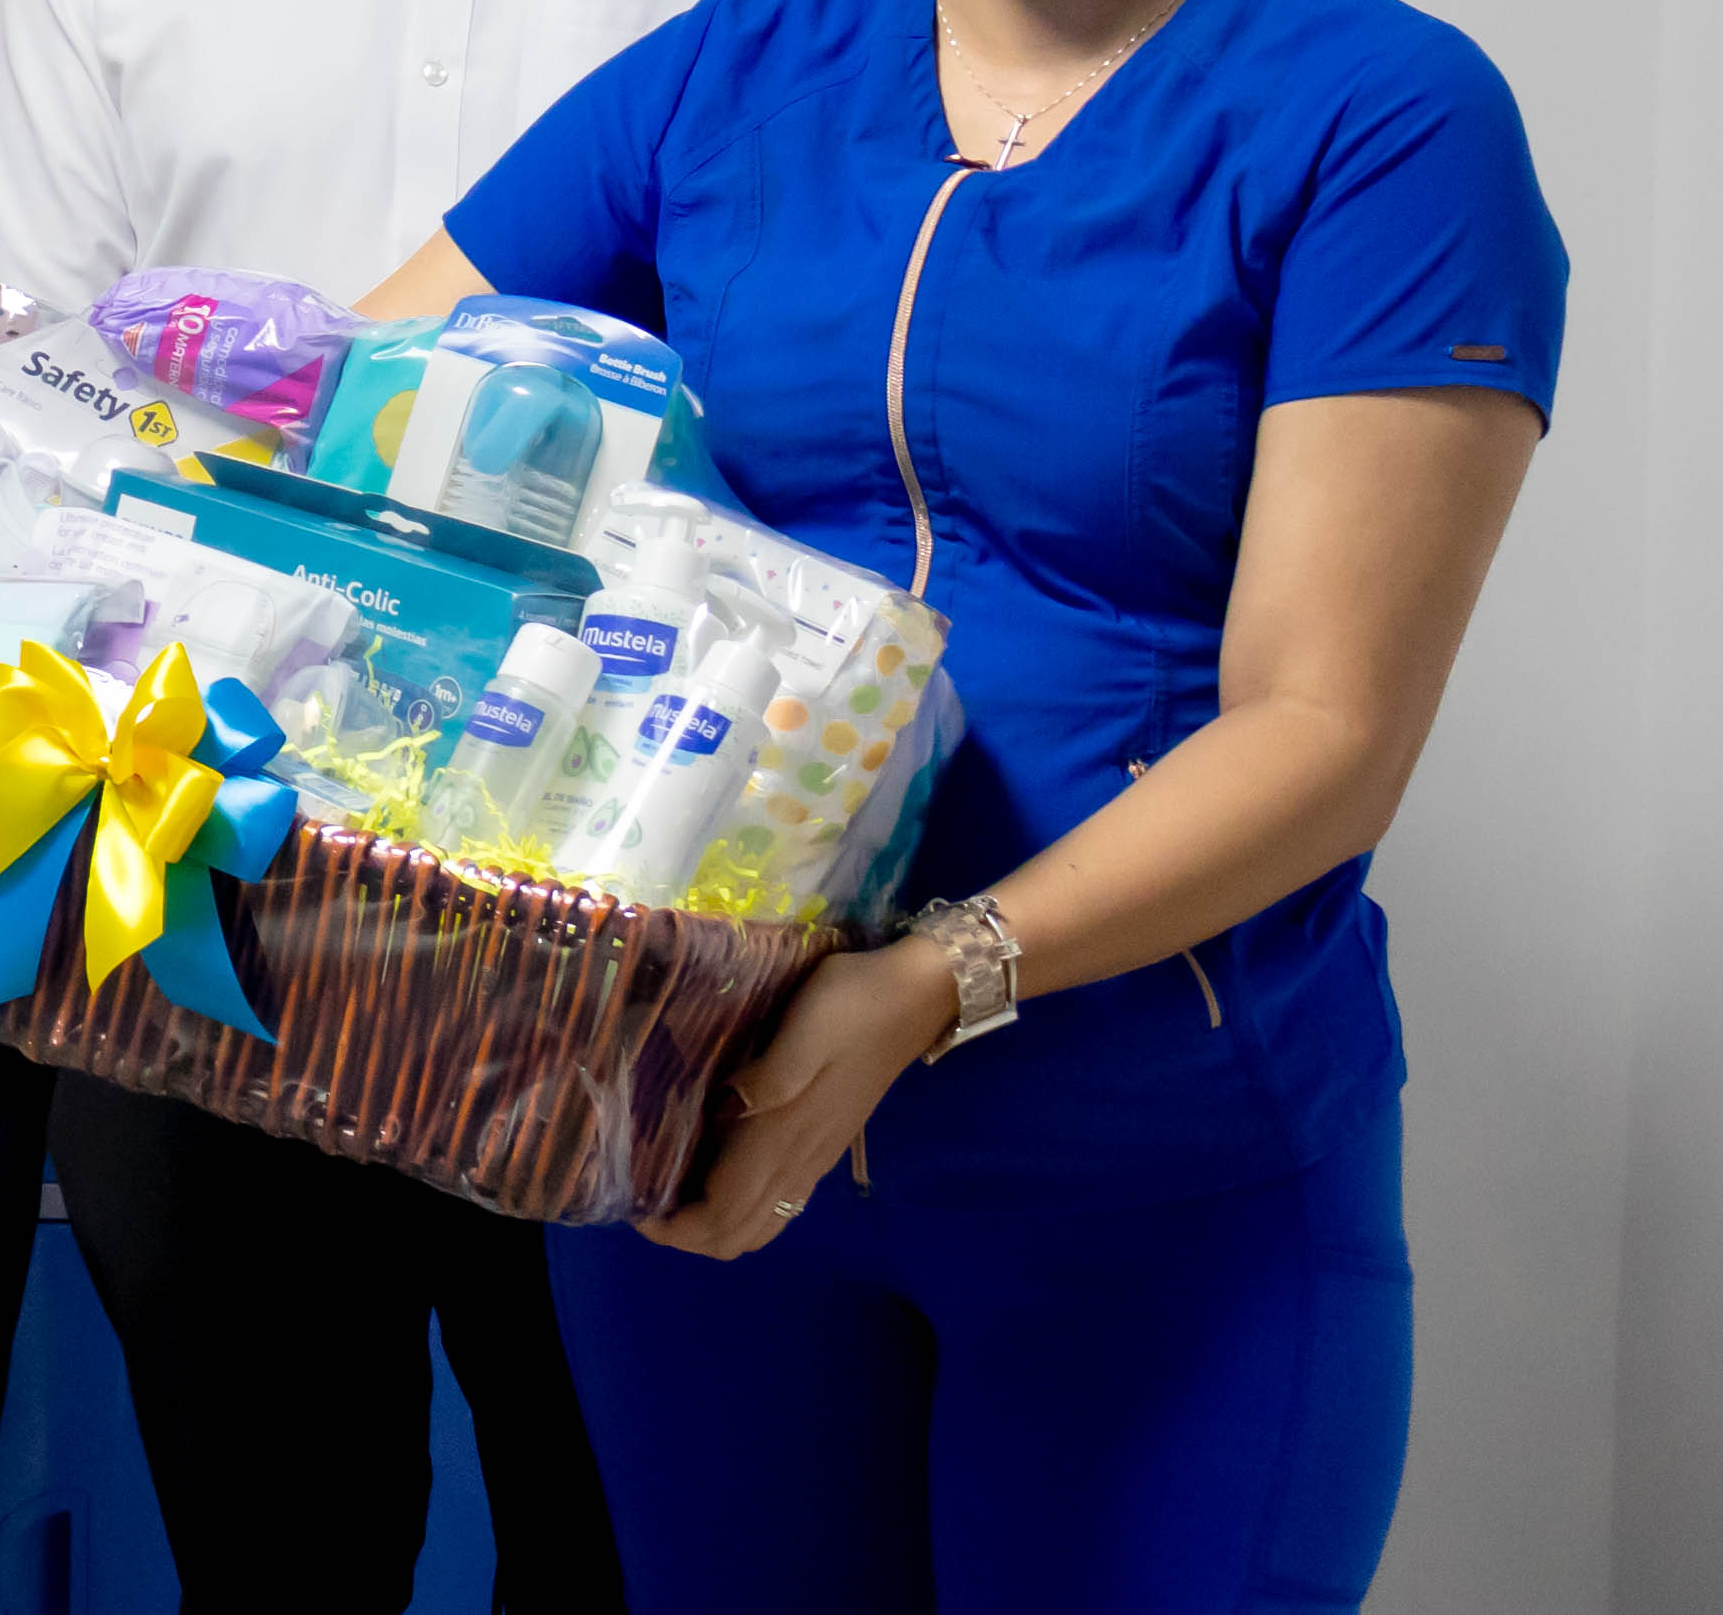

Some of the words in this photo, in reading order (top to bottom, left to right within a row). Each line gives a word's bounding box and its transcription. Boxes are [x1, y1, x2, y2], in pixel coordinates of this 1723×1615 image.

[176, 304, 210, 335] 10
[167, 333, 187, 387] MATERN
[21, 351, 131, 421] Safety
[292, 564, 401, 616] Anti-Colic
[582, 626, 667, 657] mustela
[648, 702, 717, 741] musela
